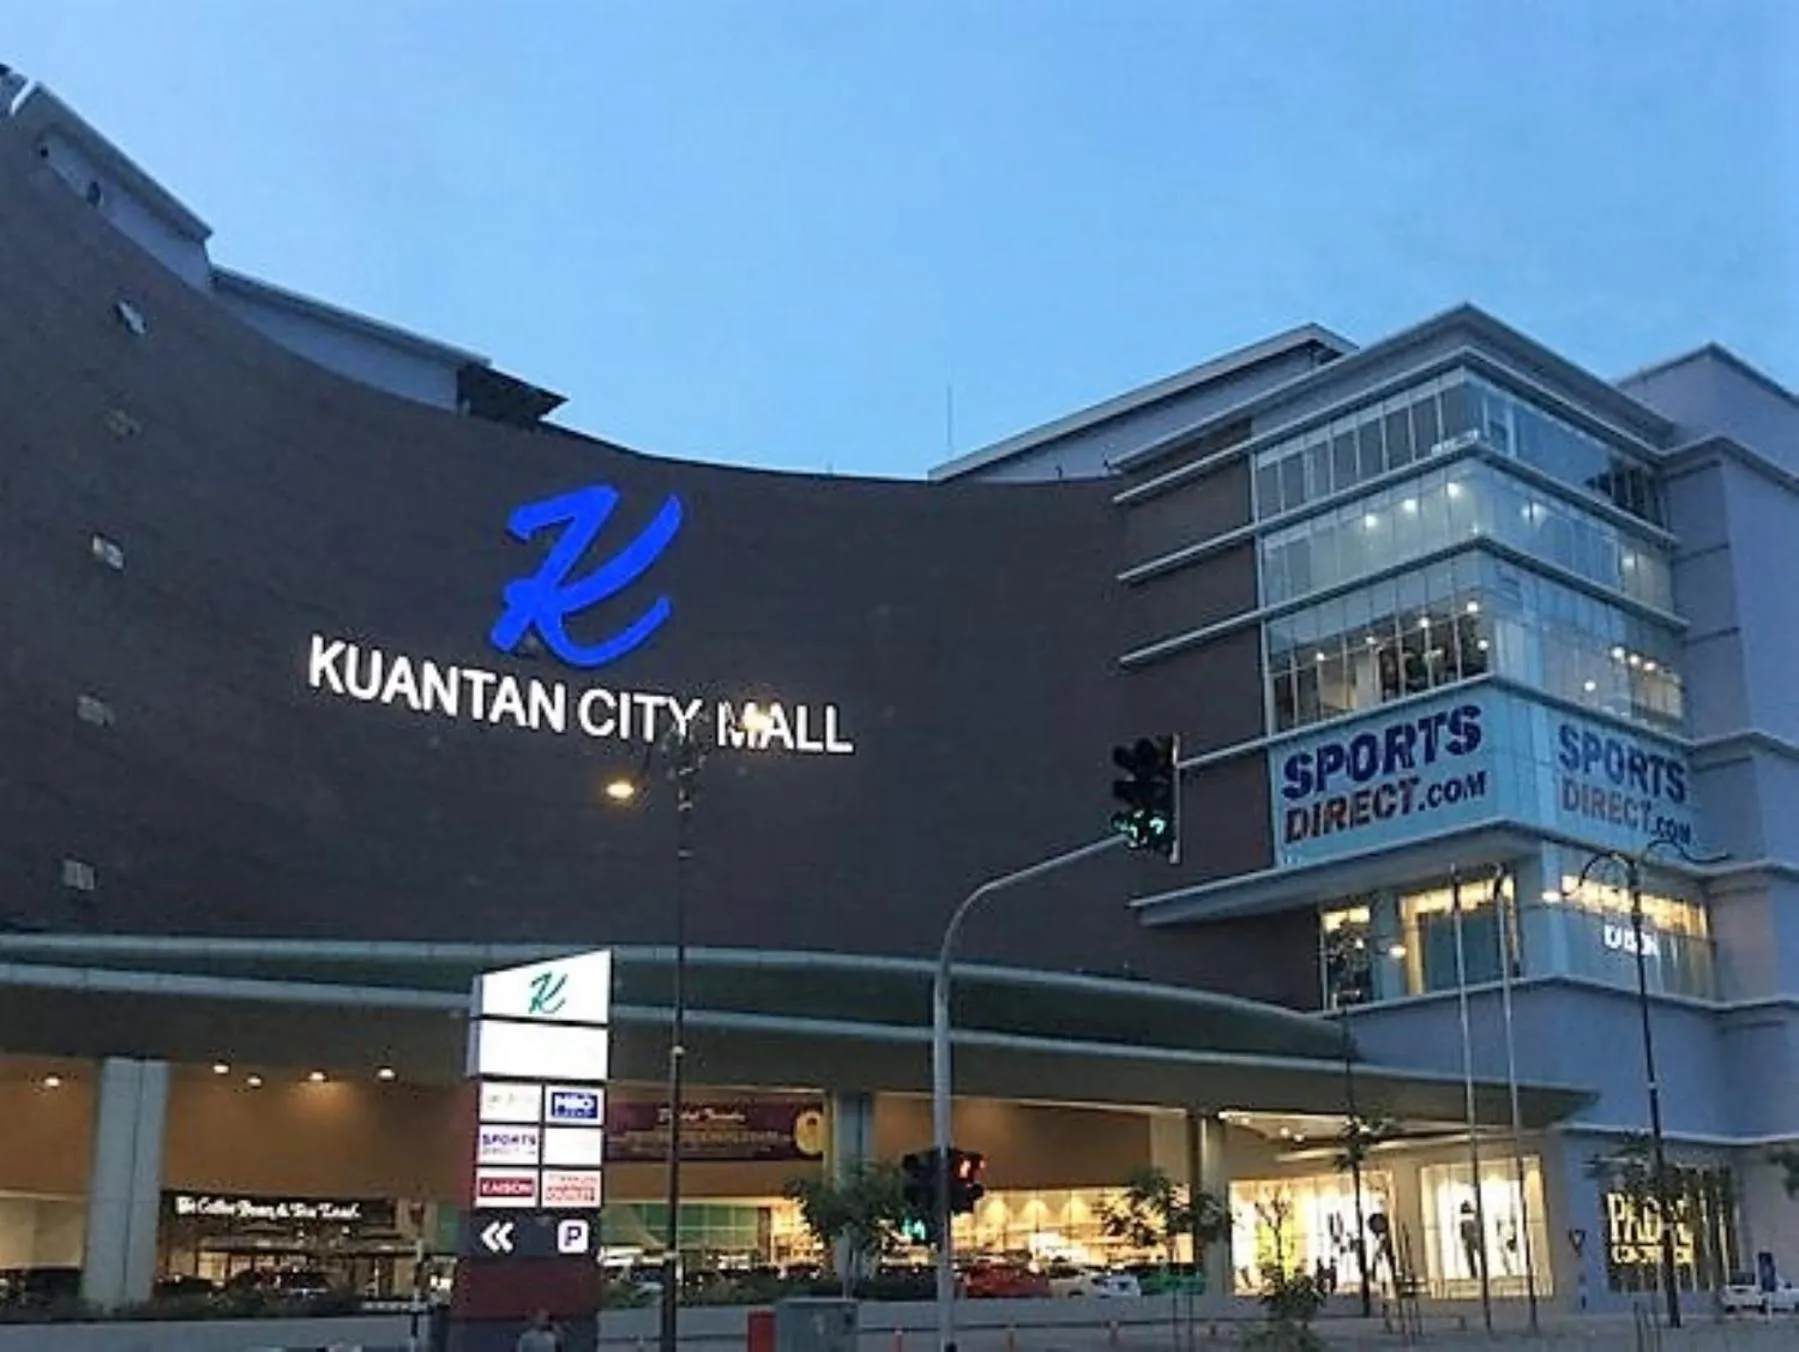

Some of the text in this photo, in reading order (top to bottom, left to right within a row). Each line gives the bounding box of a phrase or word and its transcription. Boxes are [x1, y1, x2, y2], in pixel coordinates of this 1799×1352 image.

[308, 635, 854, 753] KUANTAN CITY MALL
[1281, 704, 1483, 800] SPORTS
[1558, 722, 1686, 805] SPORTS
[1284, 771, 1486, 844] DIRECT.COM
[482, 1133, 536, 1146] SPORTS
[565, 1227, 582, 1246] P
